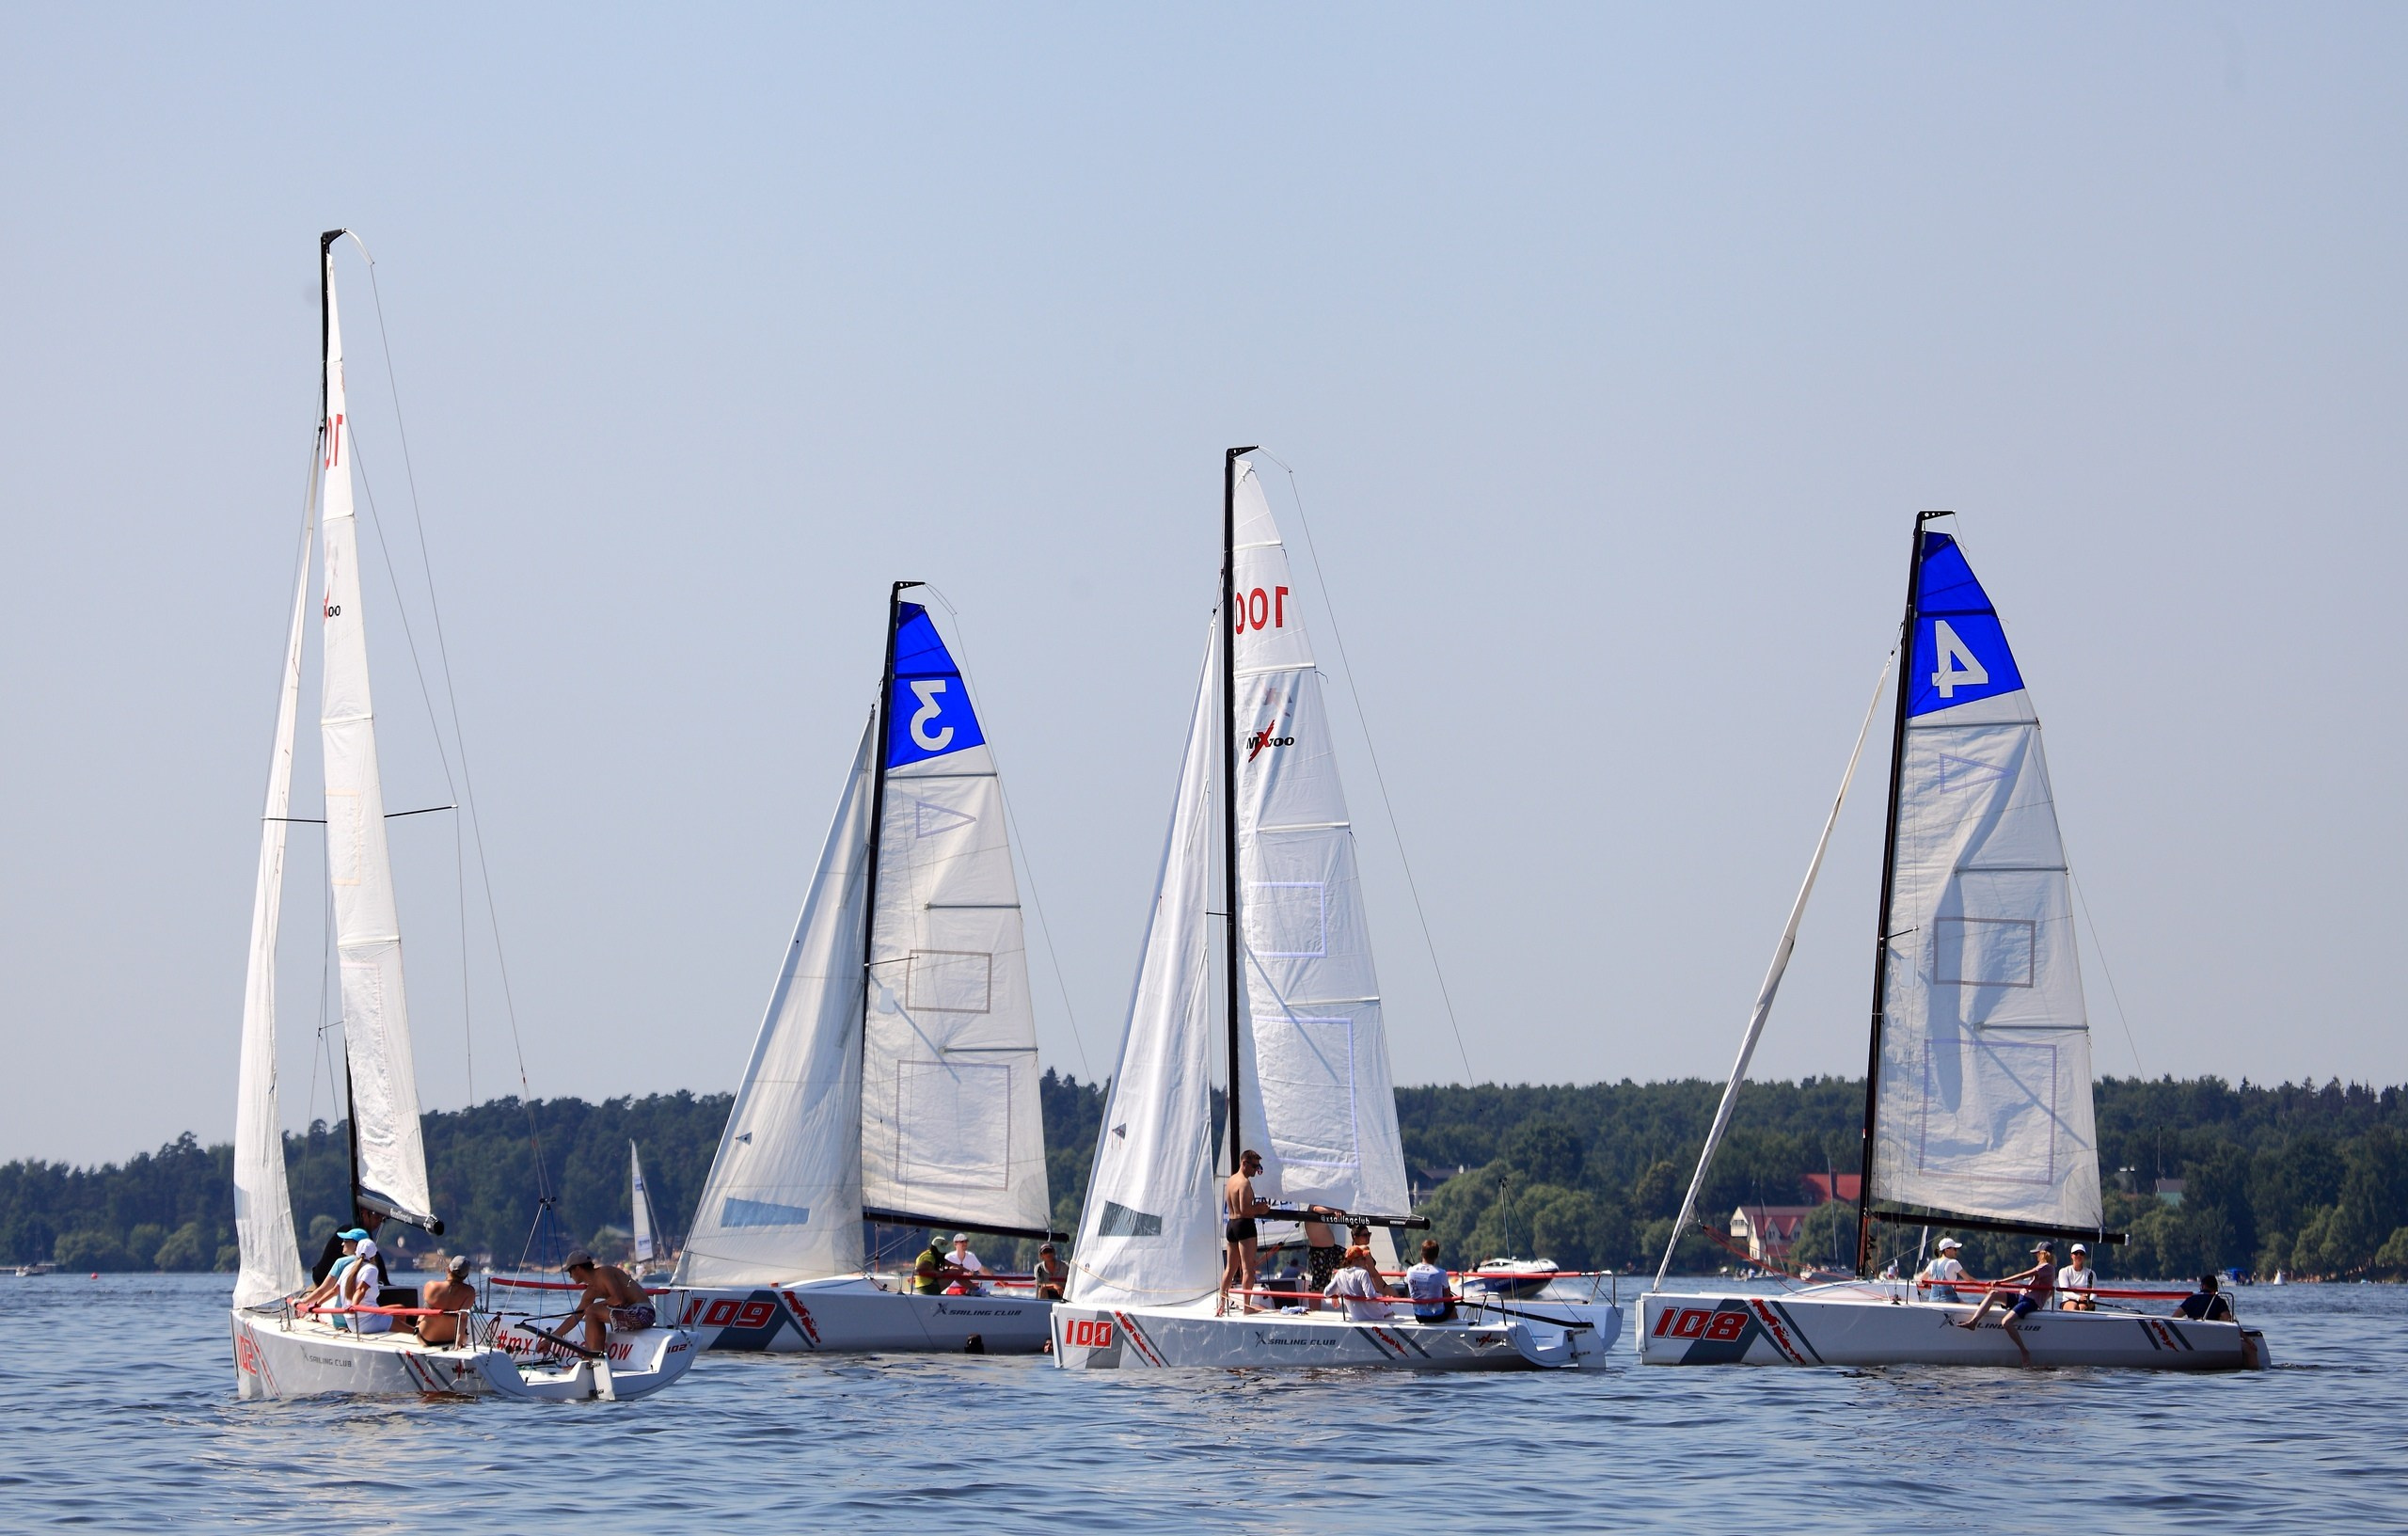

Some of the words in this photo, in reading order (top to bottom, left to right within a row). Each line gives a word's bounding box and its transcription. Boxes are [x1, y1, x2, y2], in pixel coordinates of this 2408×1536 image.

[678, 1298, 777, 1330] 109
[1651, 1306, 1750, 1342] 108
[667, 1343, 688, 1354] 102
[1065, 1319, 1113, 1349] 100
[309, 1355, 333, 1366] SAILING
